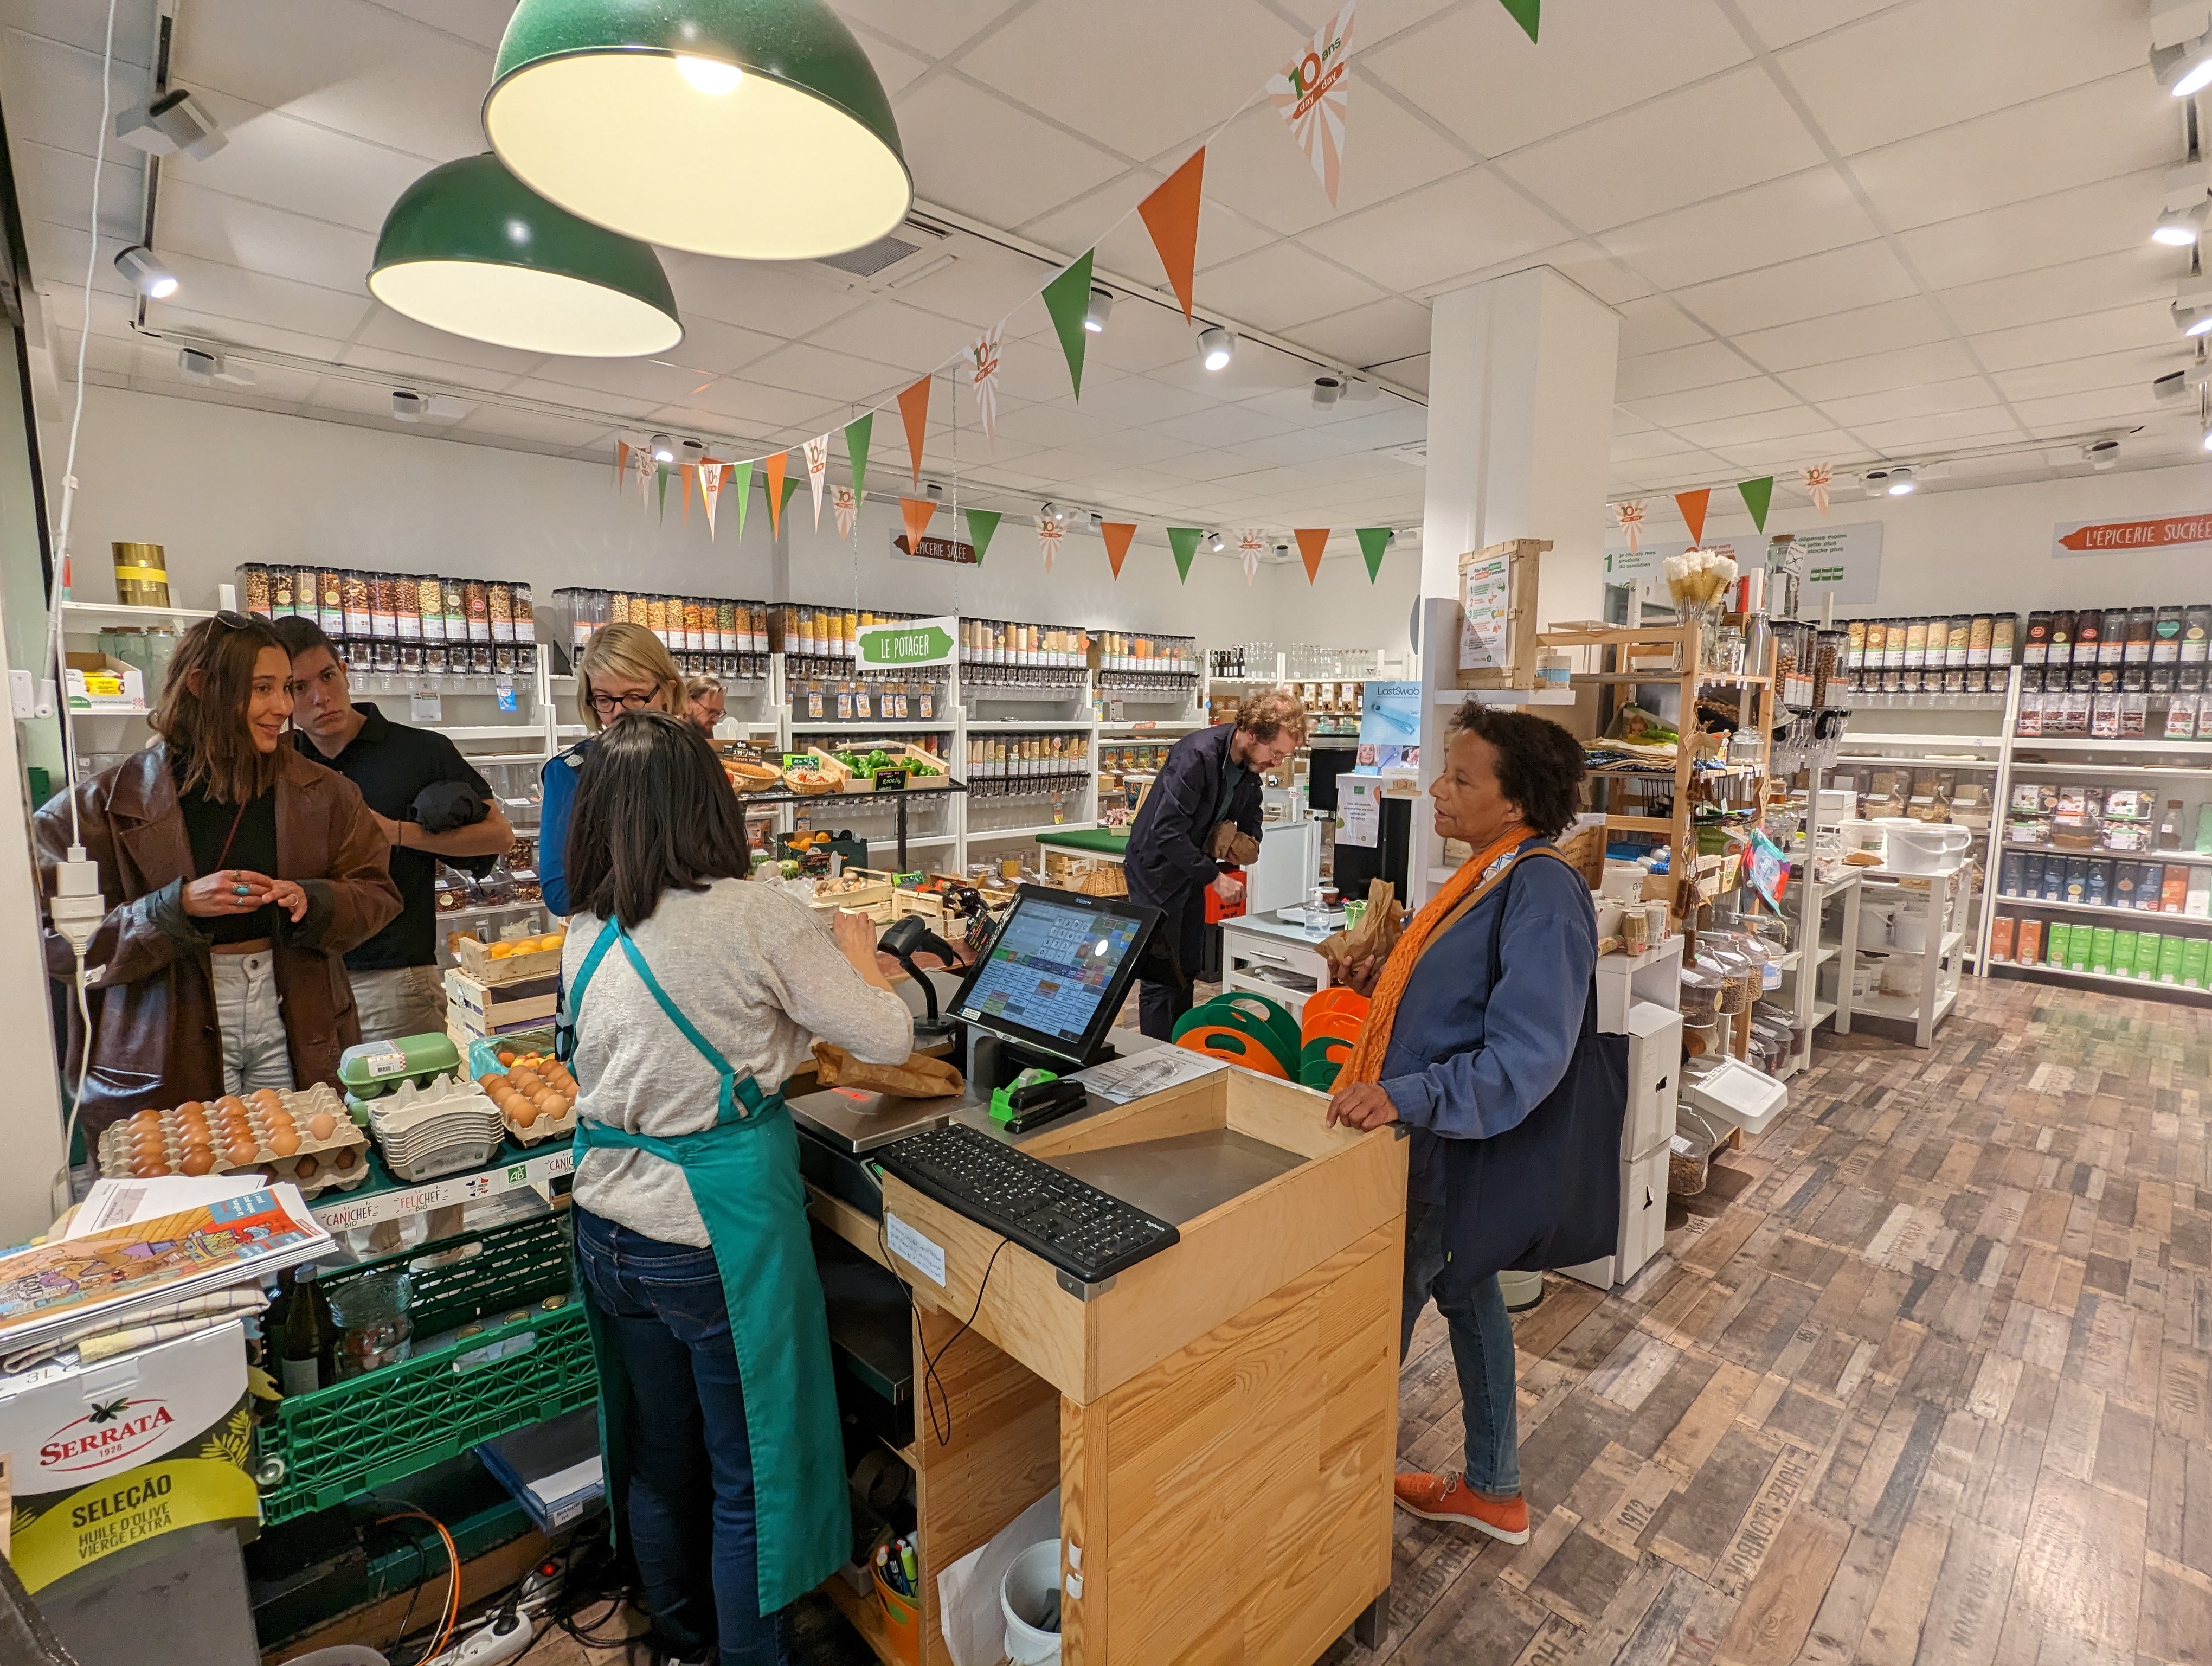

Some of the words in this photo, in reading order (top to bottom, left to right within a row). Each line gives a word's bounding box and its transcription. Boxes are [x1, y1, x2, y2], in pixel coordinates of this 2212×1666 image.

[1288, 52, 1321, 100] 10
[1322, 37, 1341, 61] ans
[1299, 93, 1314, 112] day
[1321, 71, 1337, 89] day
[974, 342, 988, 371] 10
[1806, 468, 1819, 480] 10
[1621, 505, 1634, 517] 10
[1041, 520, 1054, 532] 10
[2086, 527, 2155, 547] L'ÉPICERIE
[1604, 554, 1612, 573] 1
[880, 638, 890, 659] LE
[894, 634, 929, 659] POTAGER
[1378, 687, 1420, 695] LastSwab
[550, 1155, 573, 1171] CANIC
[510, 1170, 524, 1182] AB
[400, 1190, 441, 1209] FELICHEF
[415, 1204, 428, 1212] BIO
[326, 1206, 372, 1226] CANICHEF
[344, 1220, 358, 1228] BIO
[27, 1372, 40, 1383] 3
[44, 1369, 53, 1379] L
[40, 1406, 175, 1466] SERRATA
[99, 1444, 123, 1457] 1928
[72, 1473, 171, 1529] SELEÇÃO
[79, 1519, 116, 1546] HUILE
[121, 1502, 170, 1530] D'OLIVE
[1616, 1498, 1655, 1532] 1972
[79, 1532, 126, 1559] VIERGE
[130, 1516, 171, 1541] EXTRA
